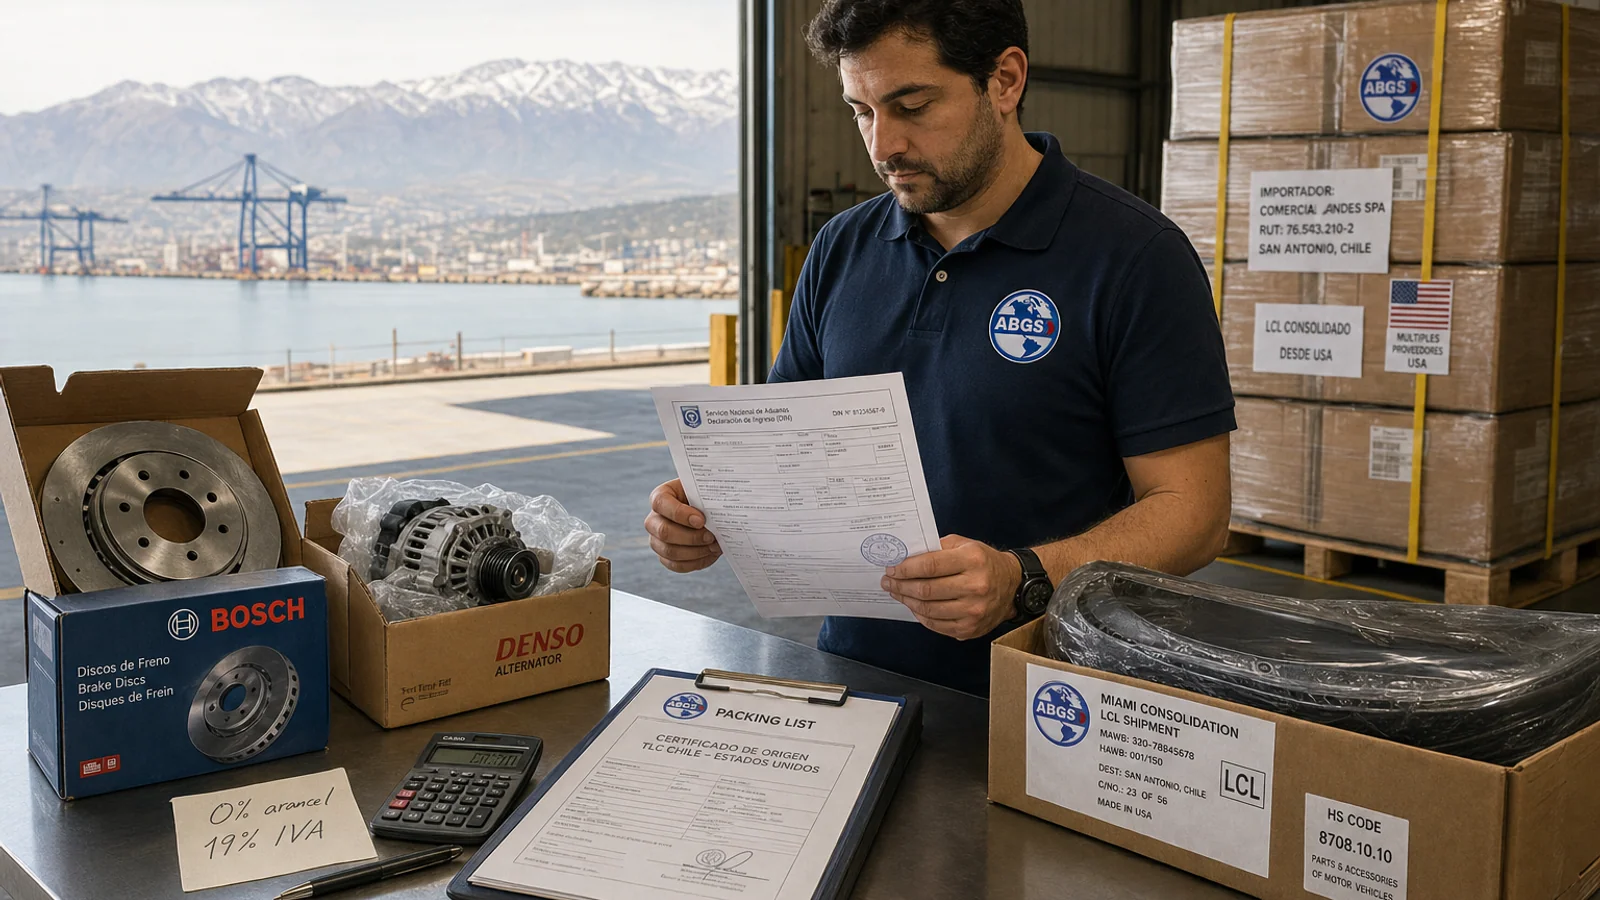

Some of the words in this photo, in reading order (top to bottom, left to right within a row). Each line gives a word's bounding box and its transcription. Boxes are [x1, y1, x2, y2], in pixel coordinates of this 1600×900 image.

[1364, 80, 1406, 94] ABGS
[1260, 185, 1335, 198] IMPORTADOR:
[1364, 202, 1386, 213] SPA
[1260, 224, 1283, 236] RUT:
[1286, 223, 1354, 234] 76.543.210-2
[1259, 244, 1280, 254] SAN
[1284, 243, 1337, 255] ANTONIO,
[1340, 243, 1371, 254] CHILE
[994, 316, 1044, 333] ABGS
[1265, 320, 1282, 333] LCL
[1284, 321, 1351, 335] CONSOLIDADO
[1397, 333, 1440, 343] MULTIPLES
[1280, 347, 1310, 361] DESDE
[1313, 349, 1333, 361] USA
[1408, 357, 1427, 369] USA
[211, 597, 304, 632] BOSCH
[495, 623, 584, 662] DENSO
[78, 664, 116, 677] Discos
[120, 660, 134, 672] de
[138, 656, 170, 669] Freno
[495, 653, 562, 677] ALTERNATOR
[78, 680, 112, 695] Brake
[116, 676, 146, 688] Discs
[79, 696, 125, 711] Disques
[128, 691, 142, 703] de
[146, 686, 174, 699] Frein
[715, 707, 782, 726] PACKING
[784, 717, 816, 730] LIST
[1036, 701, 1076, 721] ABGS
[1101, 693, 1137, 711] MIAMI
[1140, 703, 1239, 739] CONSOLIDATION
[1100, 709, 1120, 723] LCL
[1123, 715, 1180, 738] SHIPMENT
[656, 734, 739, 752] CERTIFICADO
[741, 746, 758, 755] DE
[761, 748, 809, 761] ORIGEN
[1100, 729, 1130, 743] MAWB:
[641, 742, 663, 752] TLC
[666, 746, 702, 758] CHILE
[714, 752, 769, 767] ESTADOS
[772, 761, 820, 774] UNIDOS
[1099, 744, 1127, 757] HAWB:
[1130, 751, 1163, 766] 001/150
[1098, 763, 1122, 776] DEST:
[1124, 770, 1141, 781] SAN
[1144, 775, 1181, 793] ANTONIO,
[1184, 785, 1207, 799] CHILE
[1224, 769, 1260, 801] LCL
[209, 798, 252, 825] 0%
[264, 786, 335, 815] arancel
[1126, 787, 1137, 797] 23
[1142, 791, 1153, 800] OF
[1157, 795, 1168, 805] 56
[1097, 797, 1121, 811] MADE
[1124, 804, 1133, 814] IN
[1135, 808, 1152, 820] USA
[1327, 808, 1344, 823] HS
[1347, 814, 1382, 834] CODE
[204, 828, 259, 859] 19%
[274, 819, 324, 847] IVA
[1319, 830, 1392, 864] 8708.10.10
[1311, 854, 1335, 869] PARTS
[1345, 865, 1398, 888] ACCESSORIES
[1312, 869, 1322, 879] OF
[1325, 873, 1352, 889] MOTOR
[1355, 883, 1393, 900] VEHICLES
